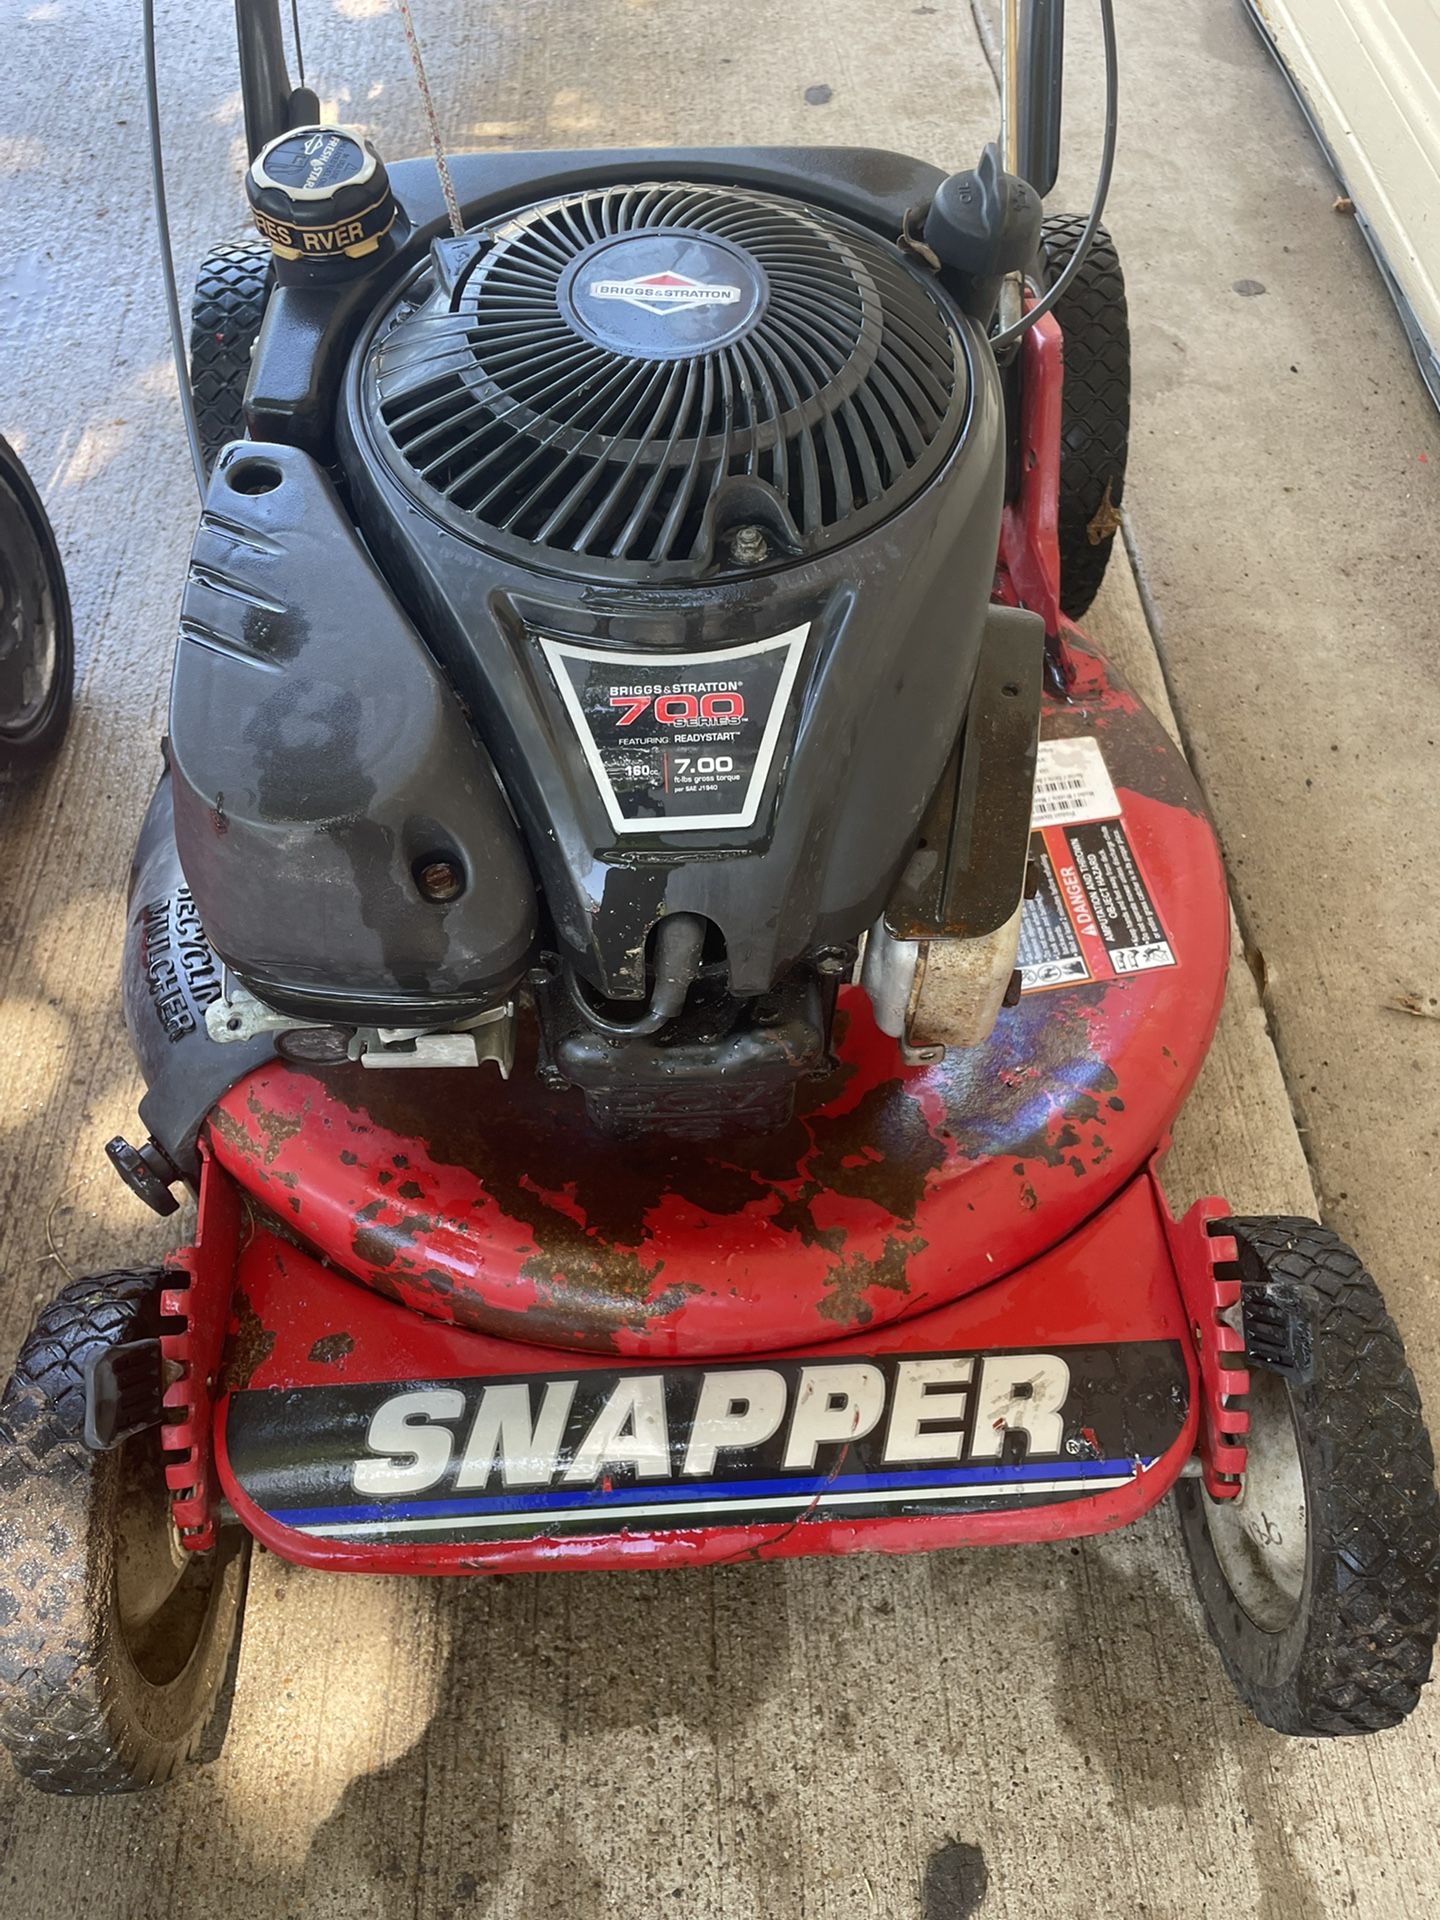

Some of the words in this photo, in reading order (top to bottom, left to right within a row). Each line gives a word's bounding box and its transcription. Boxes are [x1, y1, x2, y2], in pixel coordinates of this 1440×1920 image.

[958, 182, 972, 205] OIL
[609, 692, 745, 725] 700
[673, 715, 742, 728] SERIES
[674, 756, 733, 774] 7.00
[694, 776, 714, 785] gross
[716, 773, 740, 782] torque
[685, 784, 697, 792] SAE
[1069, 837, 1089, 872] THROWN
[1085, 853, 1106, 886] HAZARD
[1060, 866, 1092, 924] DANGER
[1081, 872, 1096, 890] AND
[1088, 890, 1115, 942] AMPUTATION
[1098, 886, 1118, 919] OBJECT
[147, 899, 196, 1043] MULCHER
[353, 1354, 1071, 1498] SNAPPER
